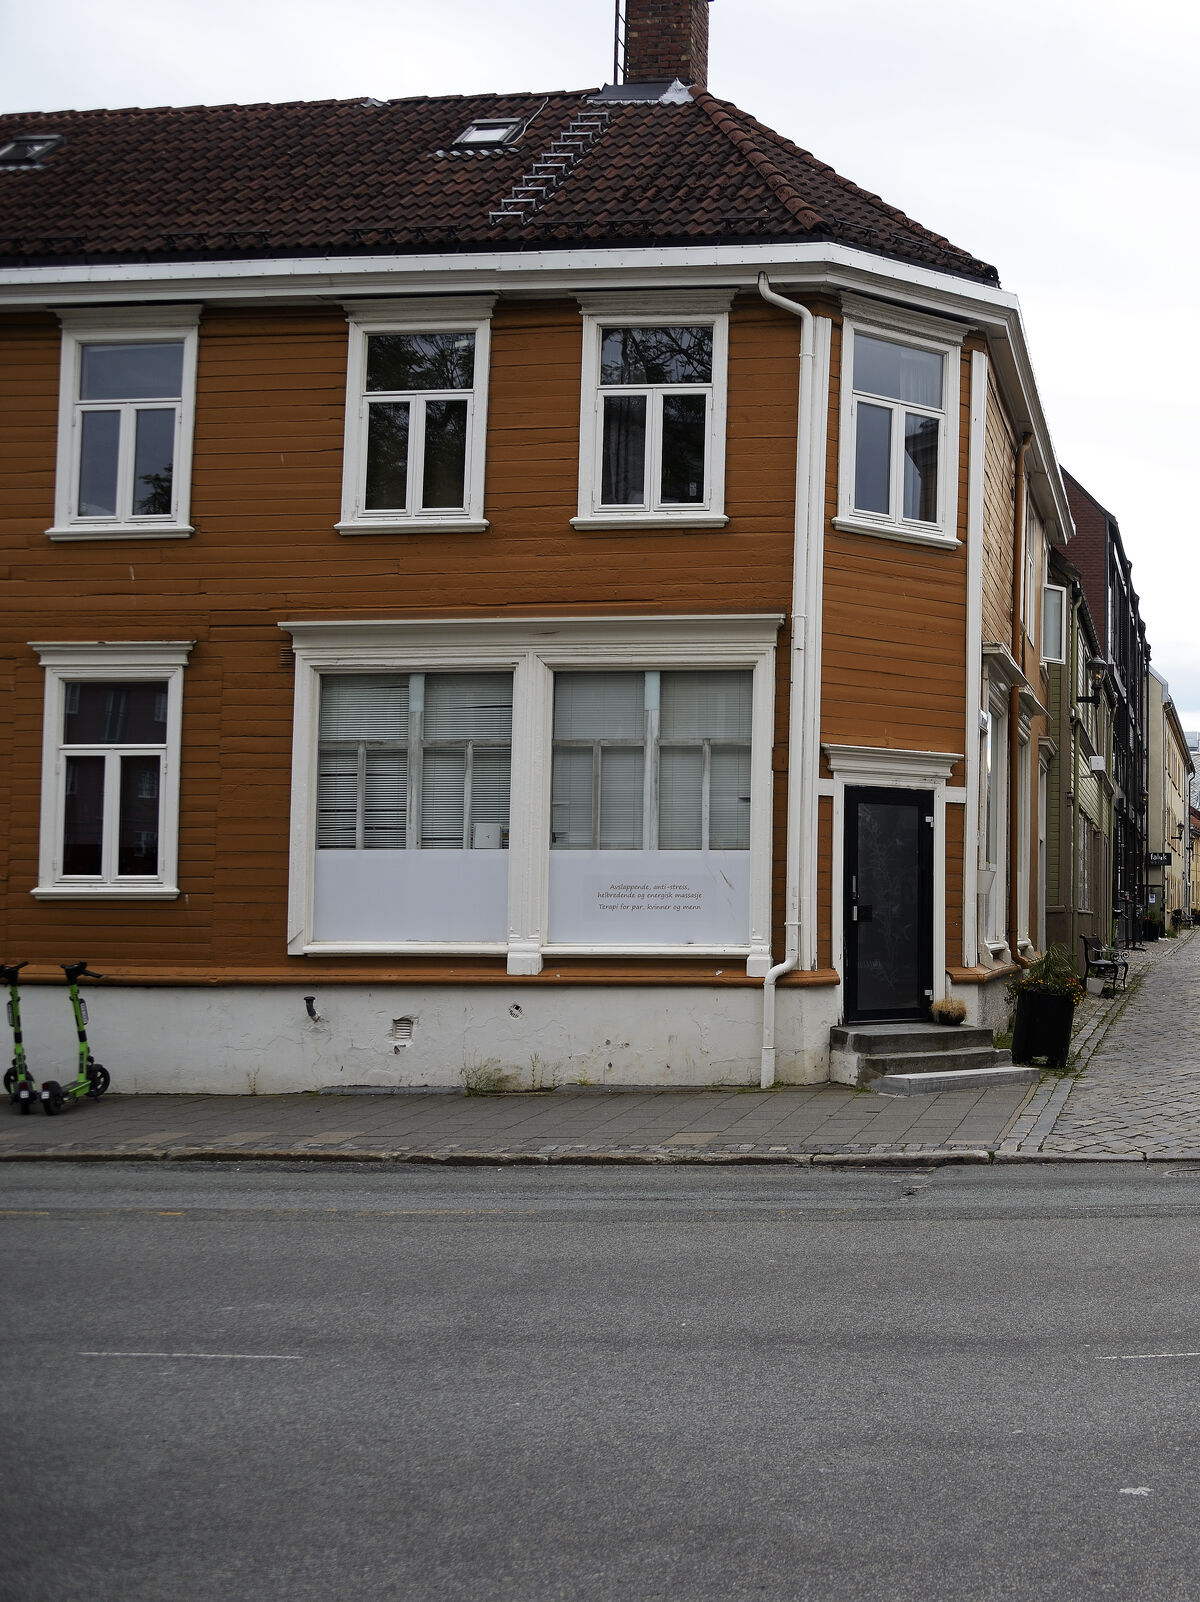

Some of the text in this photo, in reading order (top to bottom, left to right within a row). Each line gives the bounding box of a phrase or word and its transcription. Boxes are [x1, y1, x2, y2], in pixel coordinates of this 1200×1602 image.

[646, 892, 673, 900] energisk
[674, 892, 702, 900] massasje
[599, 903, 619, 911] Terapi
[620, 903, 631, 911] for
